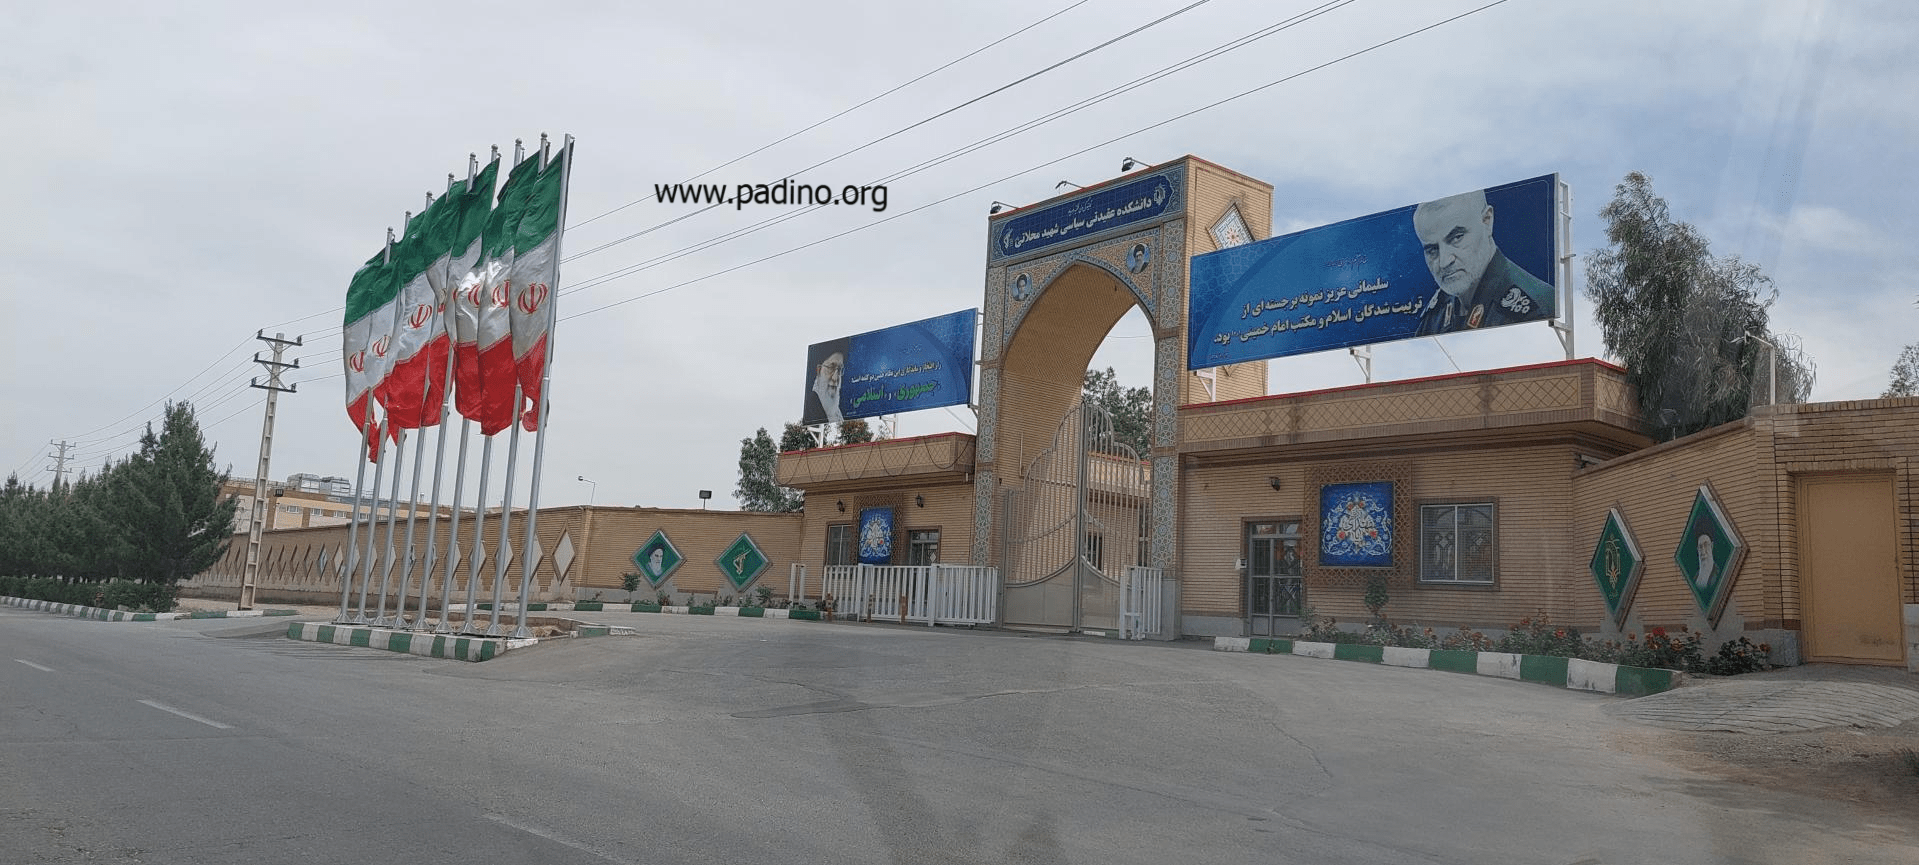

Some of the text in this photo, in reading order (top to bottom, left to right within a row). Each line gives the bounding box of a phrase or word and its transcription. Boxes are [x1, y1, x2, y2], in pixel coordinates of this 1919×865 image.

[1116, 196, 1152, 217] دانشکده
[1060, 216, 1085, 234] سیاسی
[1086, 208, 1115, 228] عقیدتی
[1014, 229, 1041, 248] محلاتی
[1041, 224, 1059, 238] شهید
[1298, 288, 1323, 306] نمونه
[1324, 286, 1347, 304] عزیز
[1348, 278, 1389, 300] سلیمانی
[1241, 303, 1250, 319] از
[1354, 301, 1390, 323] شدگان
[1391, 296, 1423, 314] تربیت
[1290, 314, 1317, 332] مکتب
[1318, 316, 1325, 329] و
[1325, 308, 1352, 327] اسلام
[1240, 322, 1270, 342] خمینی
[1270, 319, 1289, 336] امام
